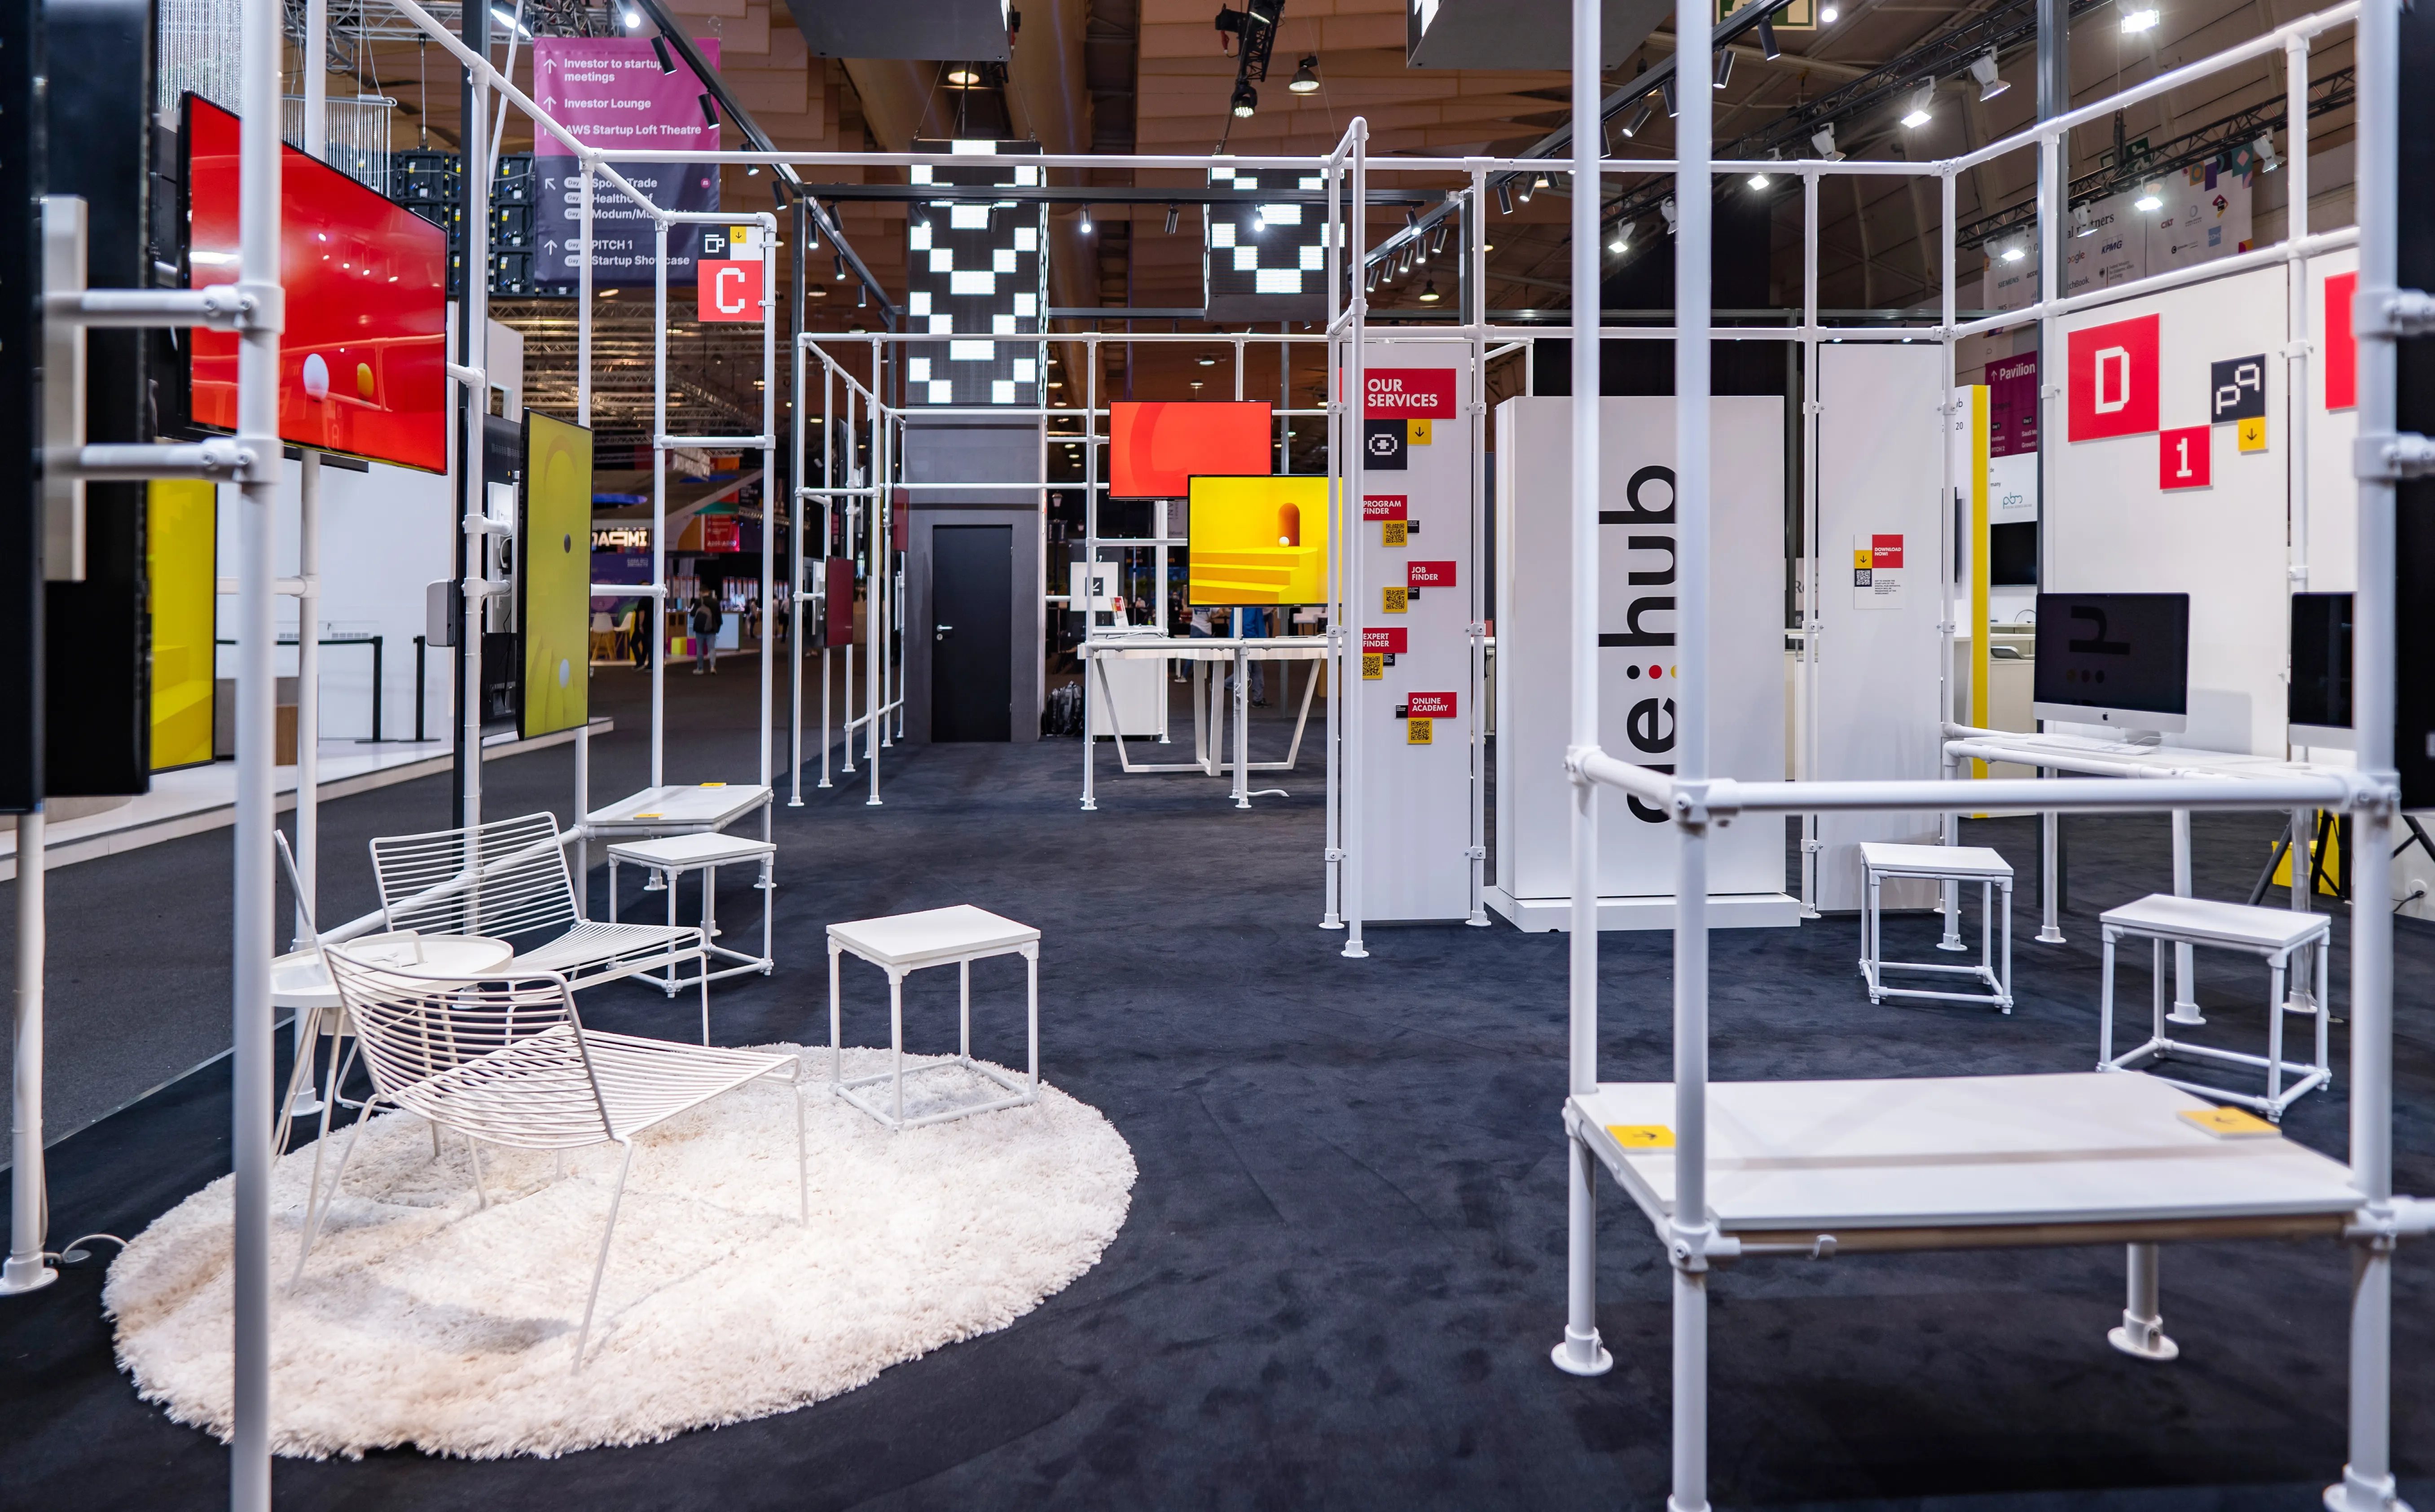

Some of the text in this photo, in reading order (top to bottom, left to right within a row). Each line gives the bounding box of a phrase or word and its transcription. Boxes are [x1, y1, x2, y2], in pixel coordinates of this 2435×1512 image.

[564, 58, 608, 68] Investor
[611, 59, 622, 68] to
[564, 72, 615, 83] meetings
[564, 98, 651, 110] Investor Lounge
[565, 125, 701, 136] AWS Startup Loft Theatre
[592, 240, 633, 250] PITCH 1
[2101, 240, 2123, 254] KPMG
[592, 255, 690, 267] Startup Shocase
[1998, 276, 2019, 289] SIEMENS
[716, 268, 745, 313] C
[2000, 363, 2035, 381] Pavilion
[1367, 379, 1403, 392] OUR
[2095, 346, 2130, 414] D
[1367, 393, 1438, 407] SERVICES
[2176, 437, 2193, 478] 1
